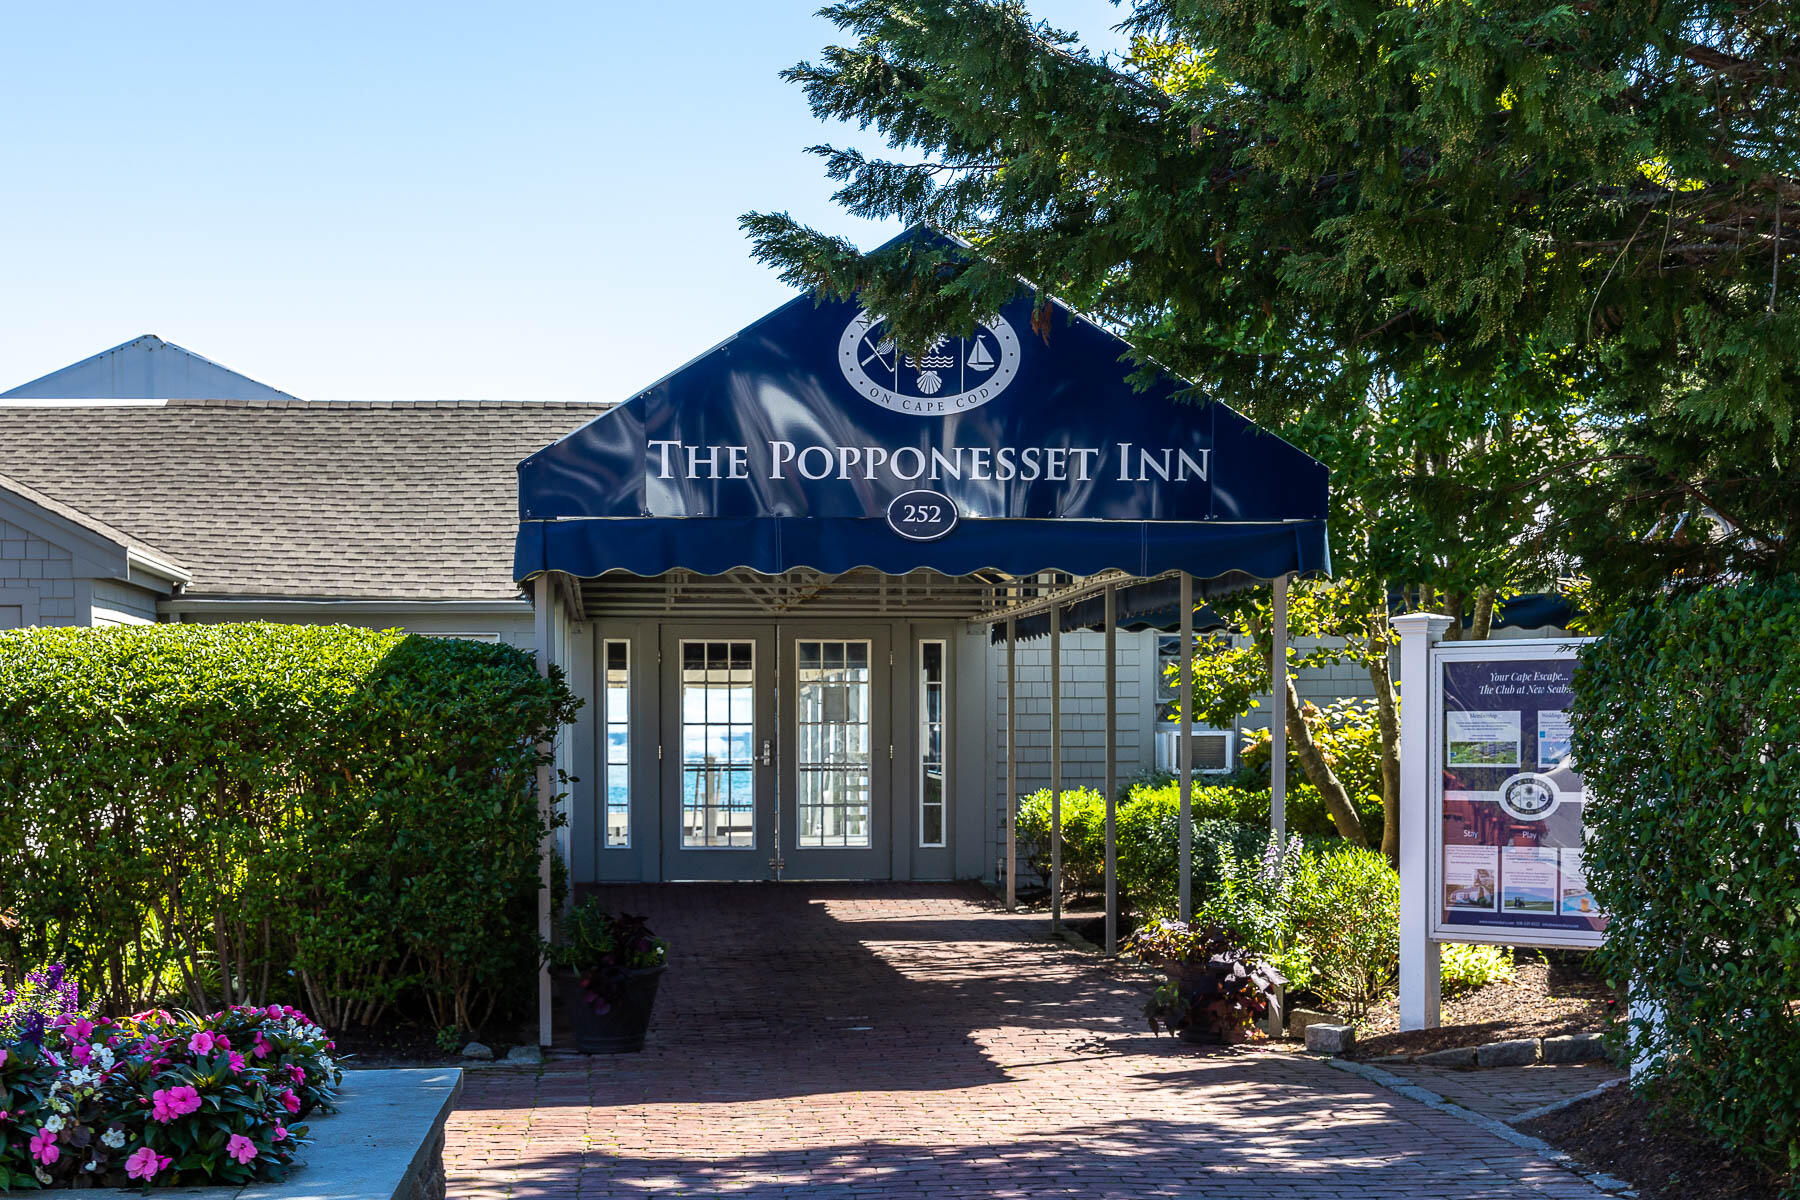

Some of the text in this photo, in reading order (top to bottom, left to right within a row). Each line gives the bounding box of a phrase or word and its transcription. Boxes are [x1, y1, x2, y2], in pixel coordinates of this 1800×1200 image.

[869, 387, 989, 412] ON CAPE COD
[647, 440, 1211, 483] THE POPPONESSET INN
[902, 504, 942, 523] 252
[1490, 672, 1510, 682] Your
[1510, 672, 1532, 683] Cape
[1478, 684, 1494, 695] The
[1495, 684, 1515, 695] Club
[1516, 685, 1526, 695] at
[1526, 684, 1546, 695] New
[1463, 829, 1479, 839] Stay
[1522, 830, 1537, 840] Play
